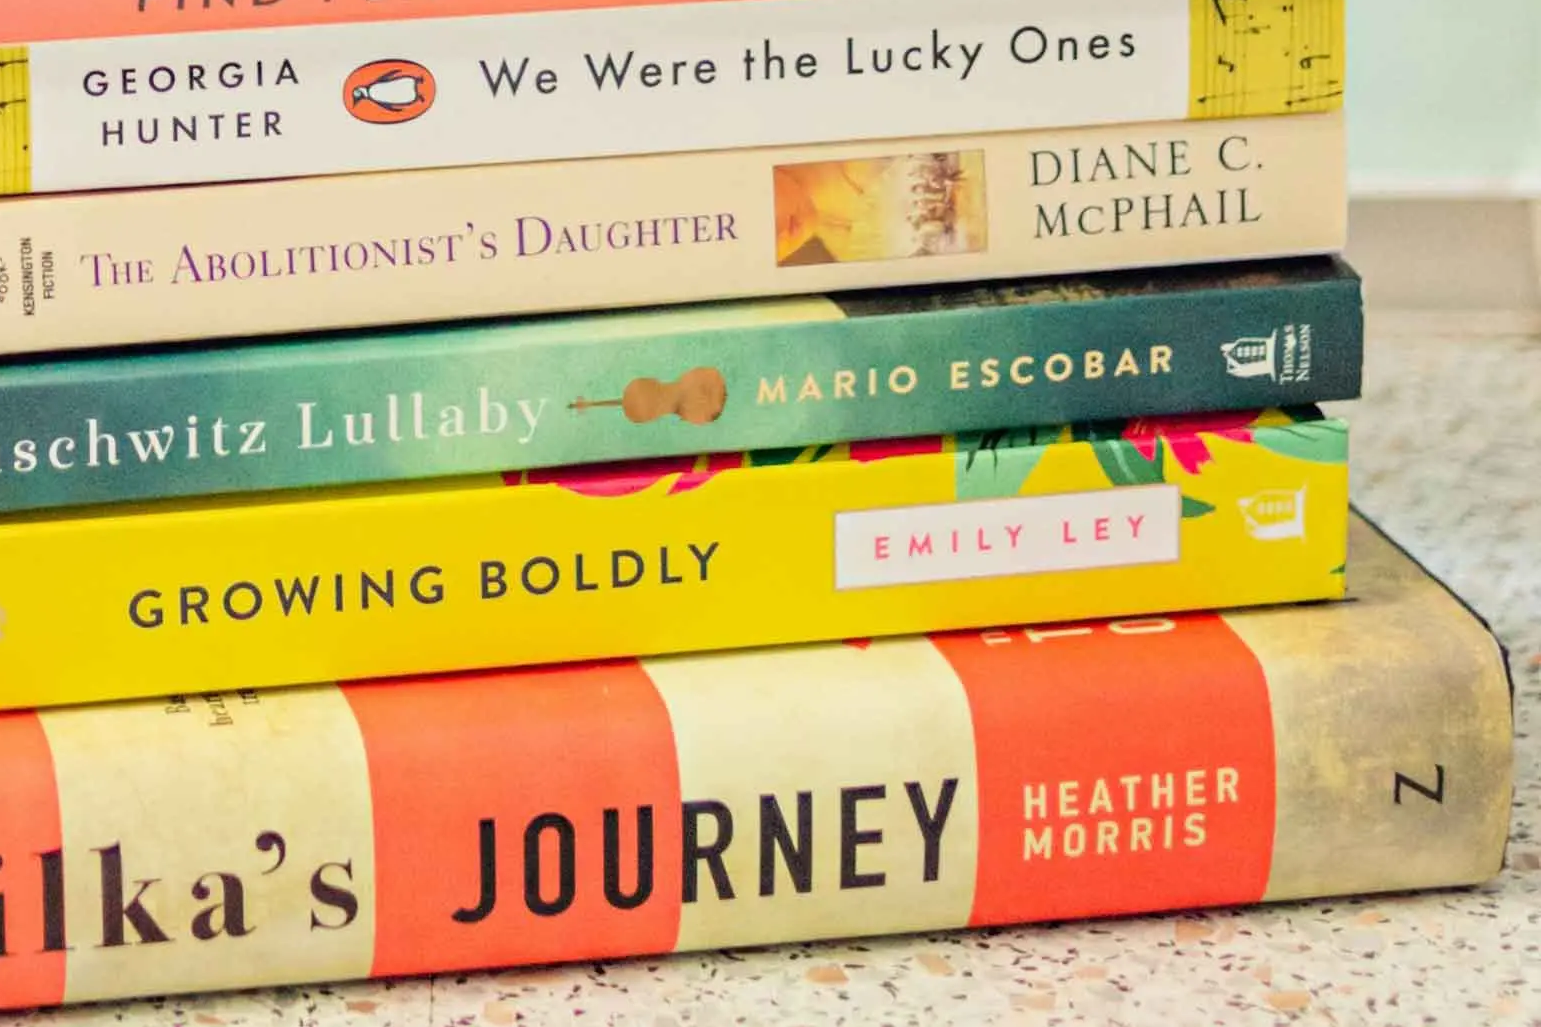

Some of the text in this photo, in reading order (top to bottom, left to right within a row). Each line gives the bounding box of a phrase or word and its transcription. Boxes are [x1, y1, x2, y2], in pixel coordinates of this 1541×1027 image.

[83, 58, 300, 98] GEORGIA
[479, 25, 1136, 99] We Were the Lucky Ones
[102, 110, 283, 147] HUNTER
[1029, 135, 1264, 187] DIANE C.
[20, 237, 35, 316] KENSINGTON
[41, 251, 55, 300] FICTION
[80, 252, 154, 287] THE
[515, 213, 739, 258] DAUGHTER
[756, 344, 1175, 405] MARIO ESCOBAR
[297, 386, 551, 450] Lullaby
[873, 514, 1147, 561] EMILY LEY
[128, 542, 720, 629] GROWING BOLDLY
[1023, 767, 1240, 820] HEATHER
[451, 778, 959, 924] JOURNEY
[1023, 812, 1208, 861] MORRIS
